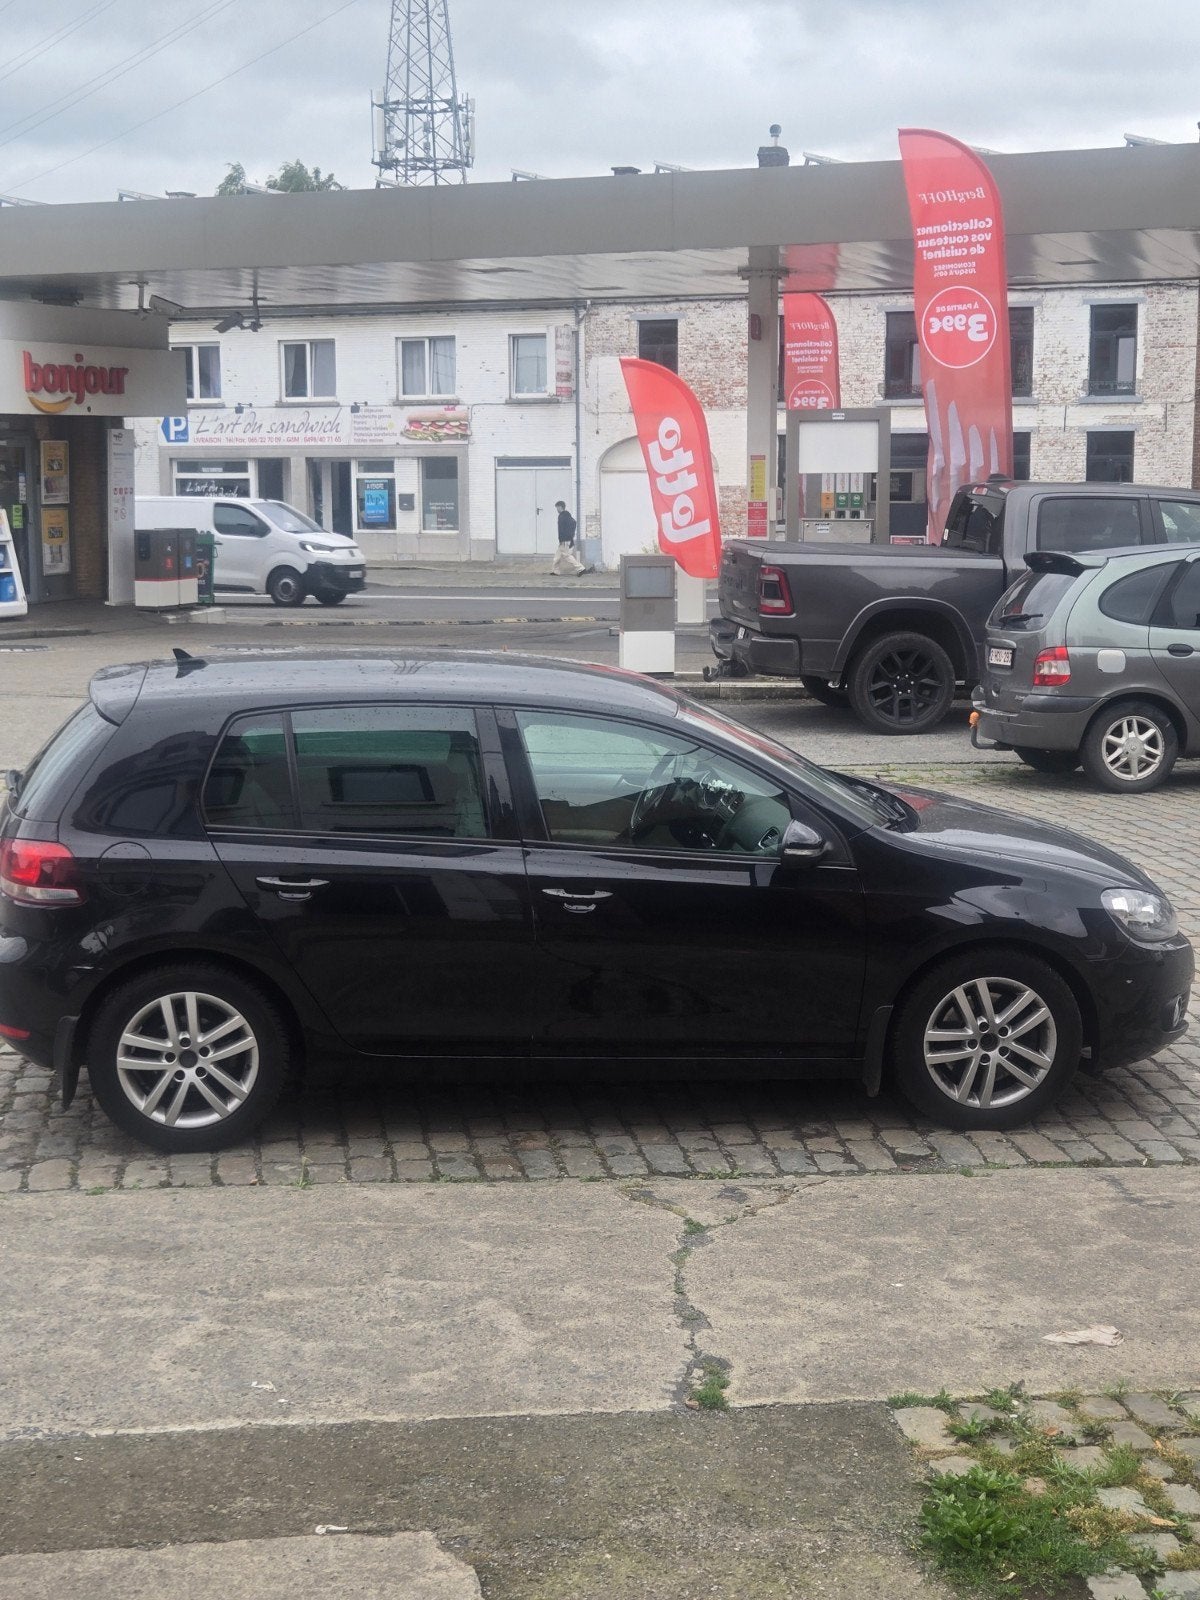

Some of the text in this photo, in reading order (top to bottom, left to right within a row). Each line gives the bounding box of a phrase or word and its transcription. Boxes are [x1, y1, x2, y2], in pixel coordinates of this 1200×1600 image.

[23, 351, 129, 404] bonjour
[170, 416, 186, 440] P
[195, 407, 342, 434] L'art du sandwich
[193, 436, 222, 444] LIVRAISON
